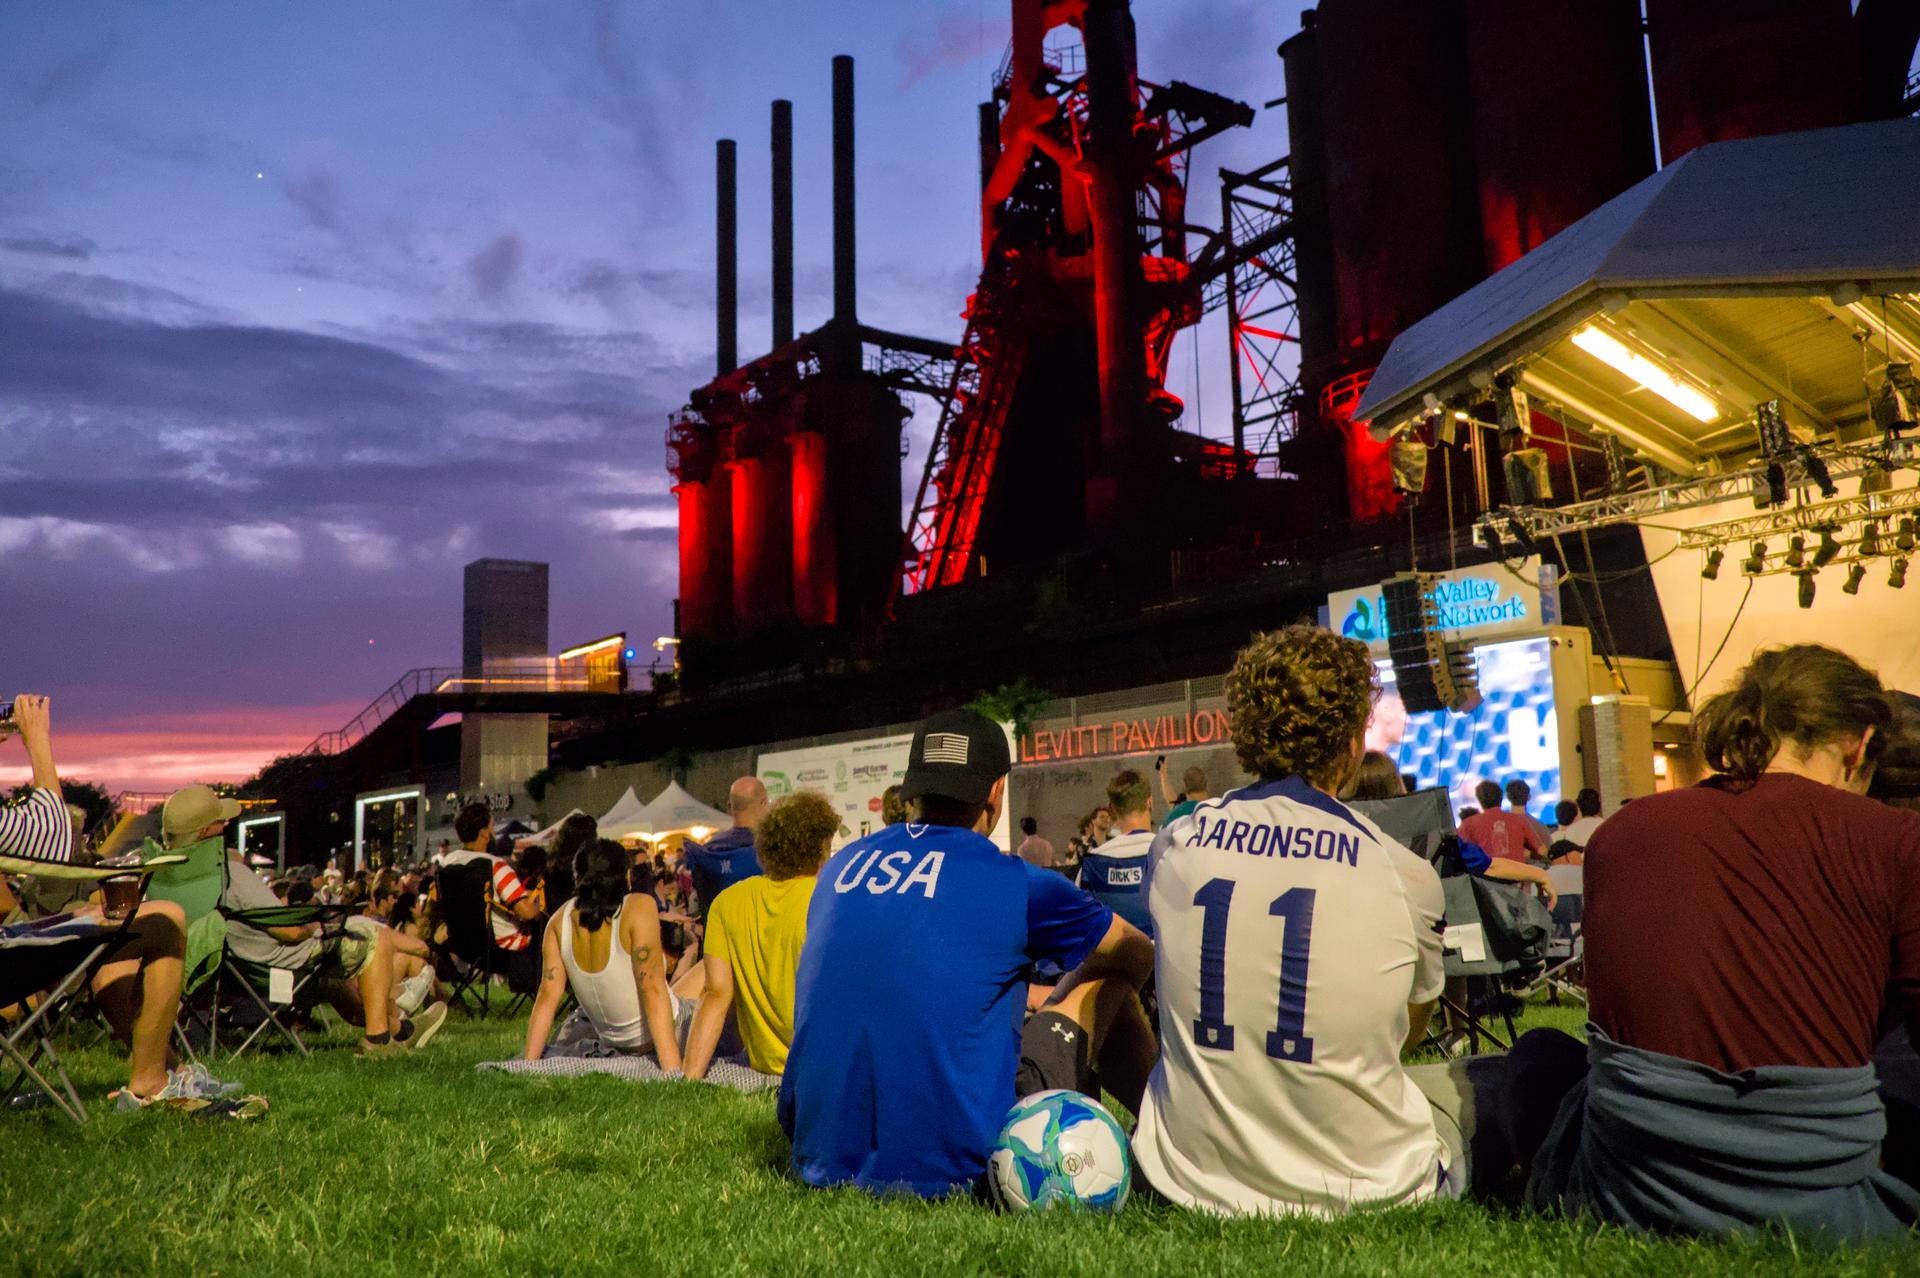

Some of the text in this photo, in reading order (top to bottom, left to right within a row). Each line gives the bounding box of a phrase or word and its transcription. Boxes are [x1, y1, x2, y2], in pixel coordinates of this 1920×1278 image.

[1438, 579, 1498, 603] Valley
[1440, 595, 1525, 628] Network
[1021, 708, 1233, 762] LEVITT PAVILION
[1185, 816, 1360, 867] AARONSON
[834, 850, 945, 899] USA
[1109, 868, 1141, 884] DICK'S
[1193, 877, 1317, 1064] 11
